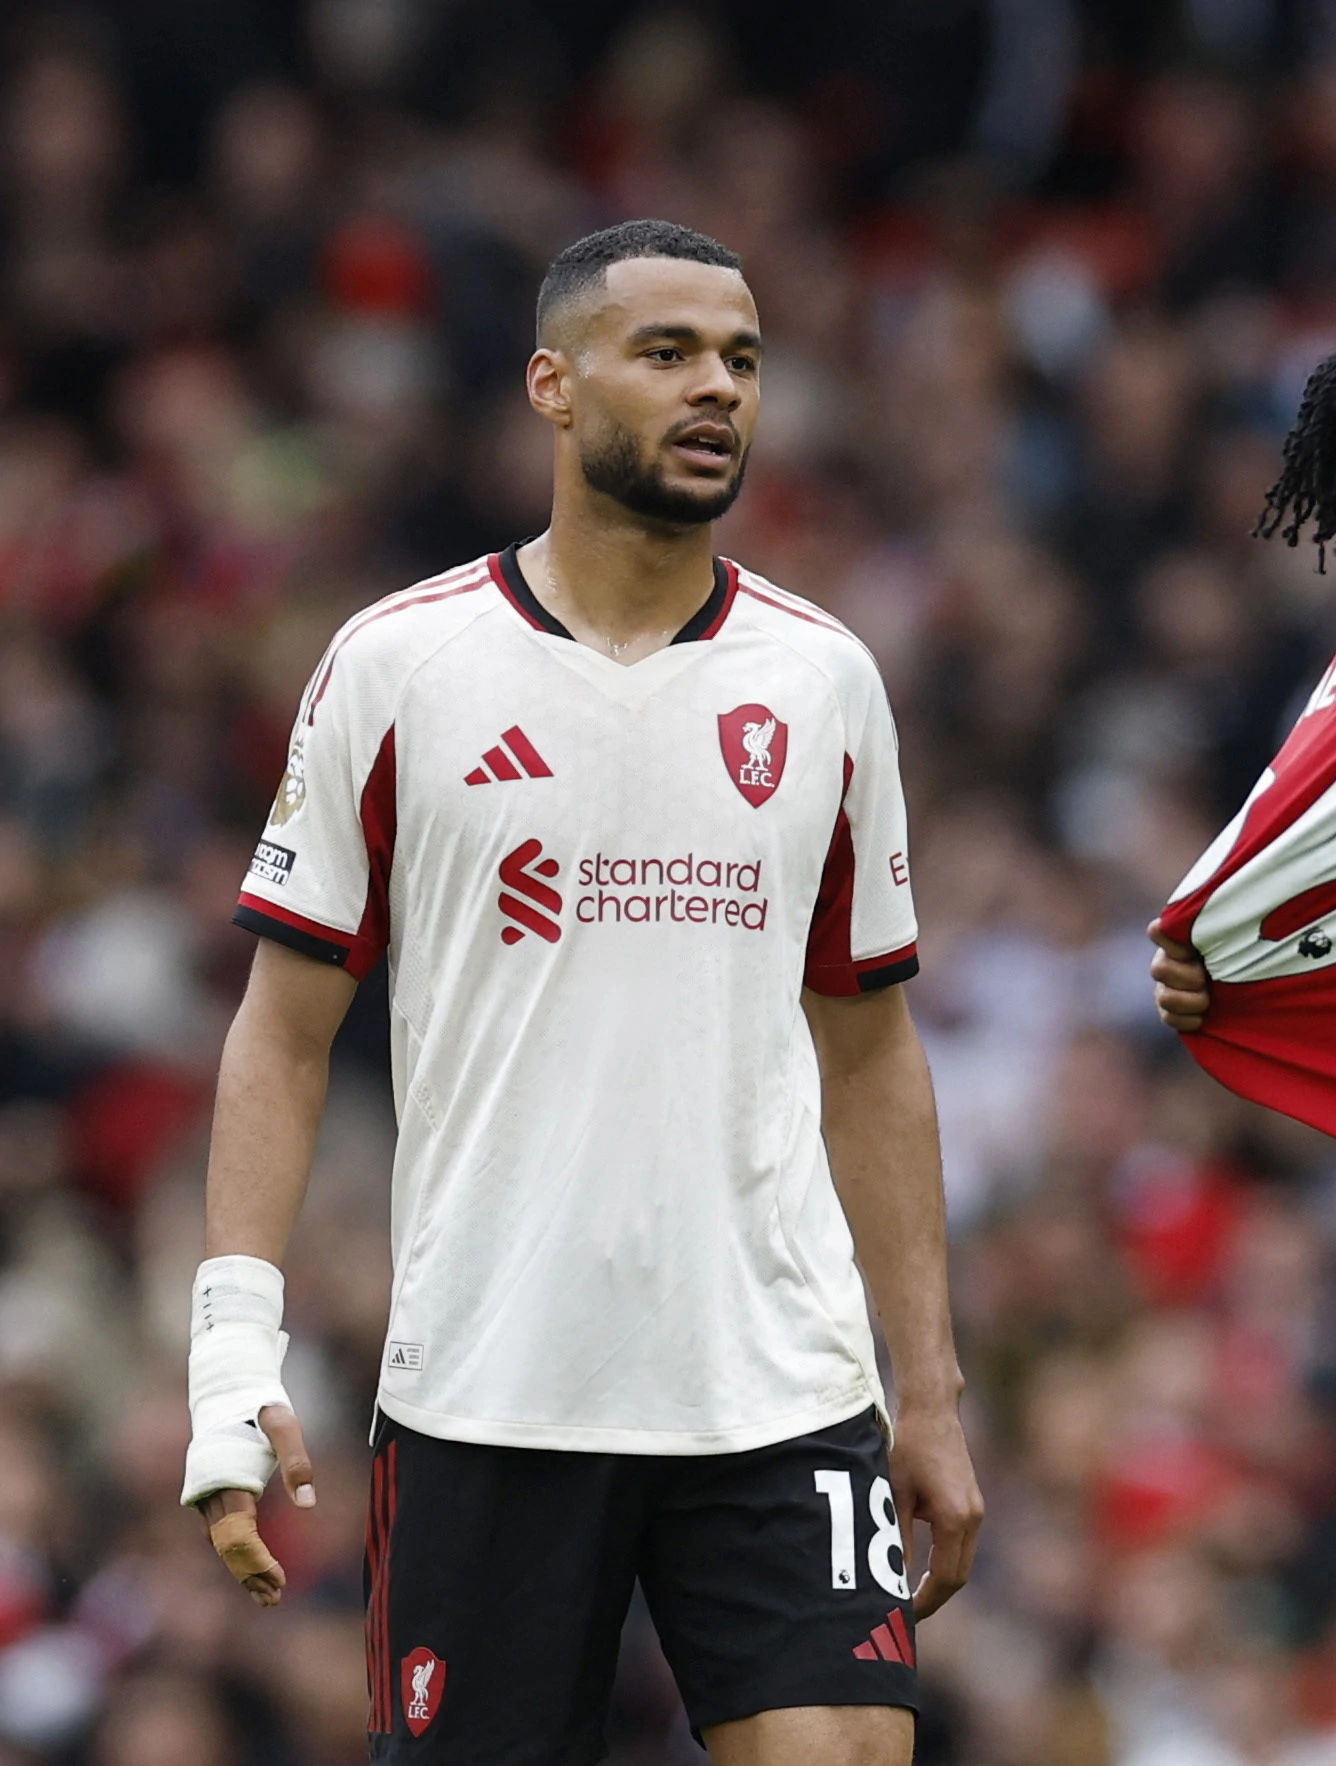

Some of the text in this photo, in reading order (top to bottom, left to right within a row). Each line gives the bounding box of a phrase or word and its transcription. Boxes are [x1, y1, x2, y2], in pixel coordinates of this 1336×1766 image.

[578, 852, 761, 892] standard
[576, 888, 768, 931] chartered
[814, 1469, 911, 1600] 18
